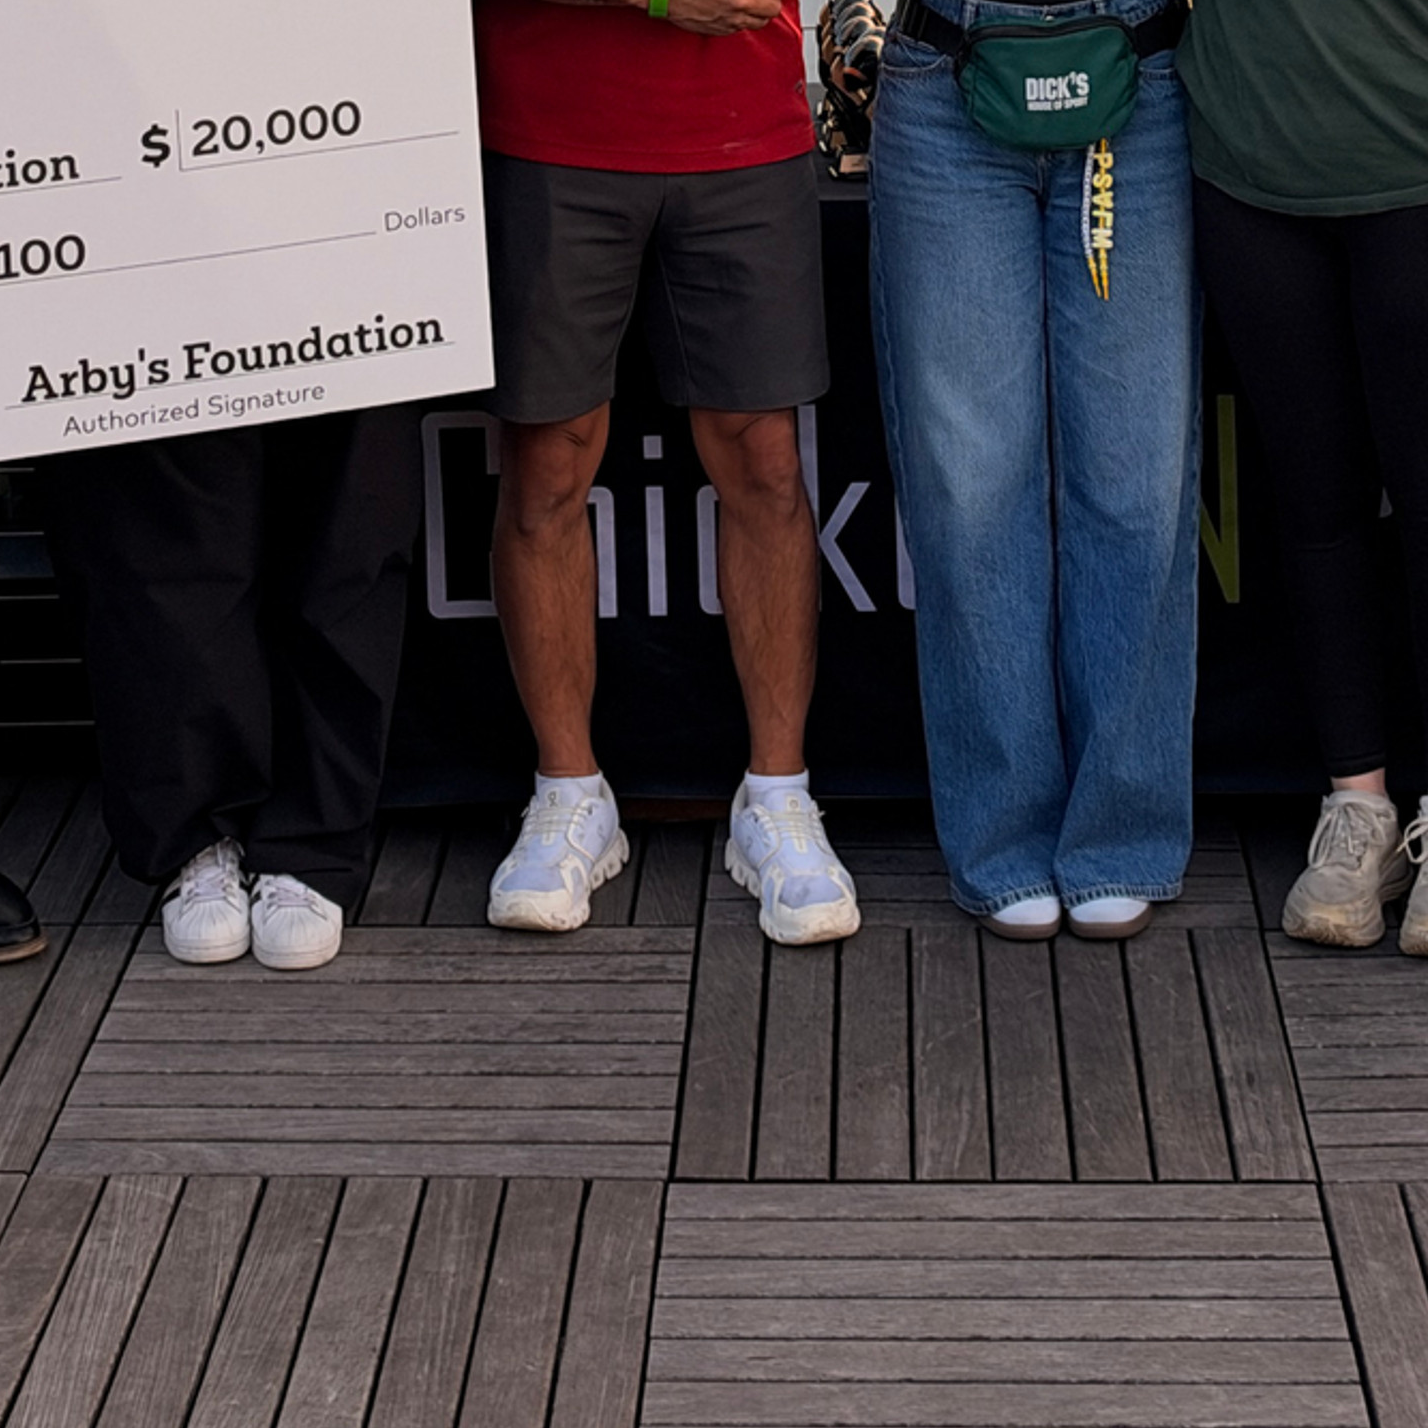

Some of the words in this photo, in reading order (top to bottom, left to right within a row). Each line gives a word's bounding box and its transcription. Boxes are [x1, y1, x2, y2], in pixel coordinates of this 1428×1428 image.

[1025, 71, 1090, 101] DICK'S
[140, 123, 172, 168] $
[190, 100, 362, 158] 20,000
[383, 202, 466, 234] Dollars
[20, 347, 172, 405] Arby's
[182, 313, 445, 382] Foundation
[63, 397, 201, 437] Authorized
[207, 382, 327, 418] Signature
